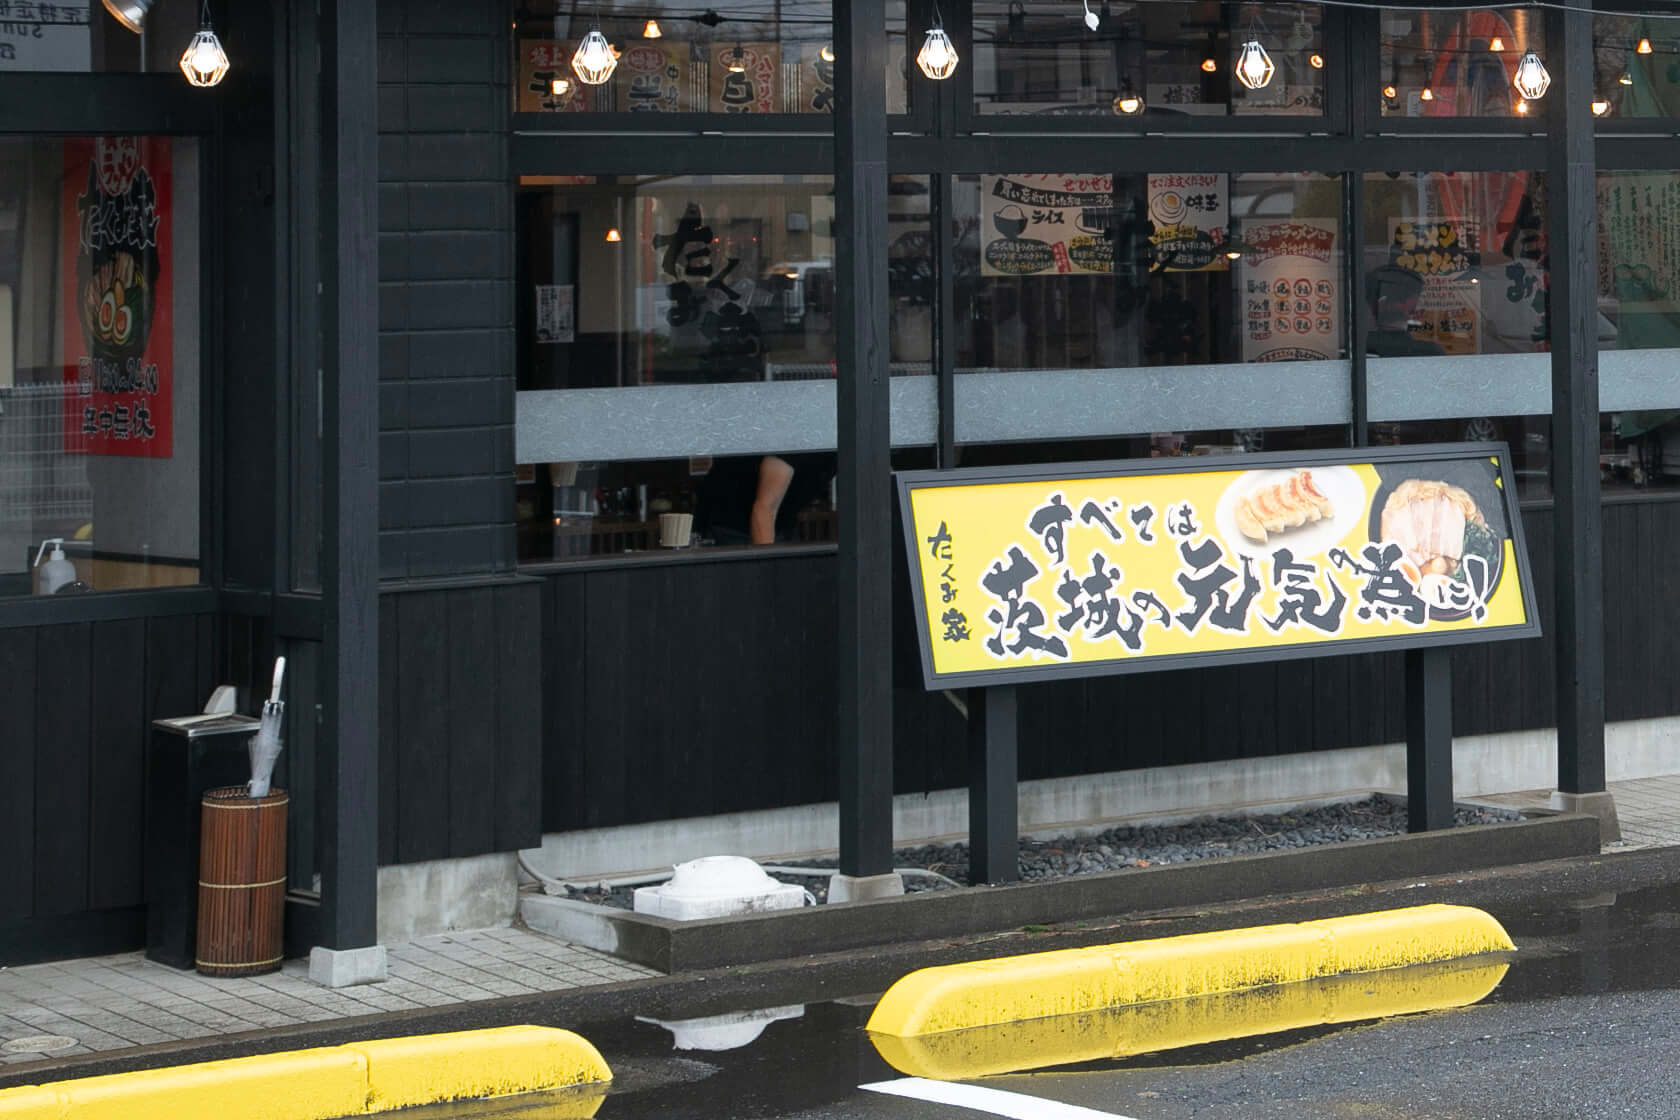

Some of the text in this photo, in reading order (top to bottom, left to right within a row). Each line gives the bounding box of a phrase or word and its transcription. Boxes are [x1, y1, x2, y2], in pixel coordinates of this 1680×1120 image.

[1032, 209, 1065, 225] ライス
[81, 398, 156, 443] 年中無休
[1027, 491, 1203, 566] すべては
[927, 520, 971, 643] たくみ家
